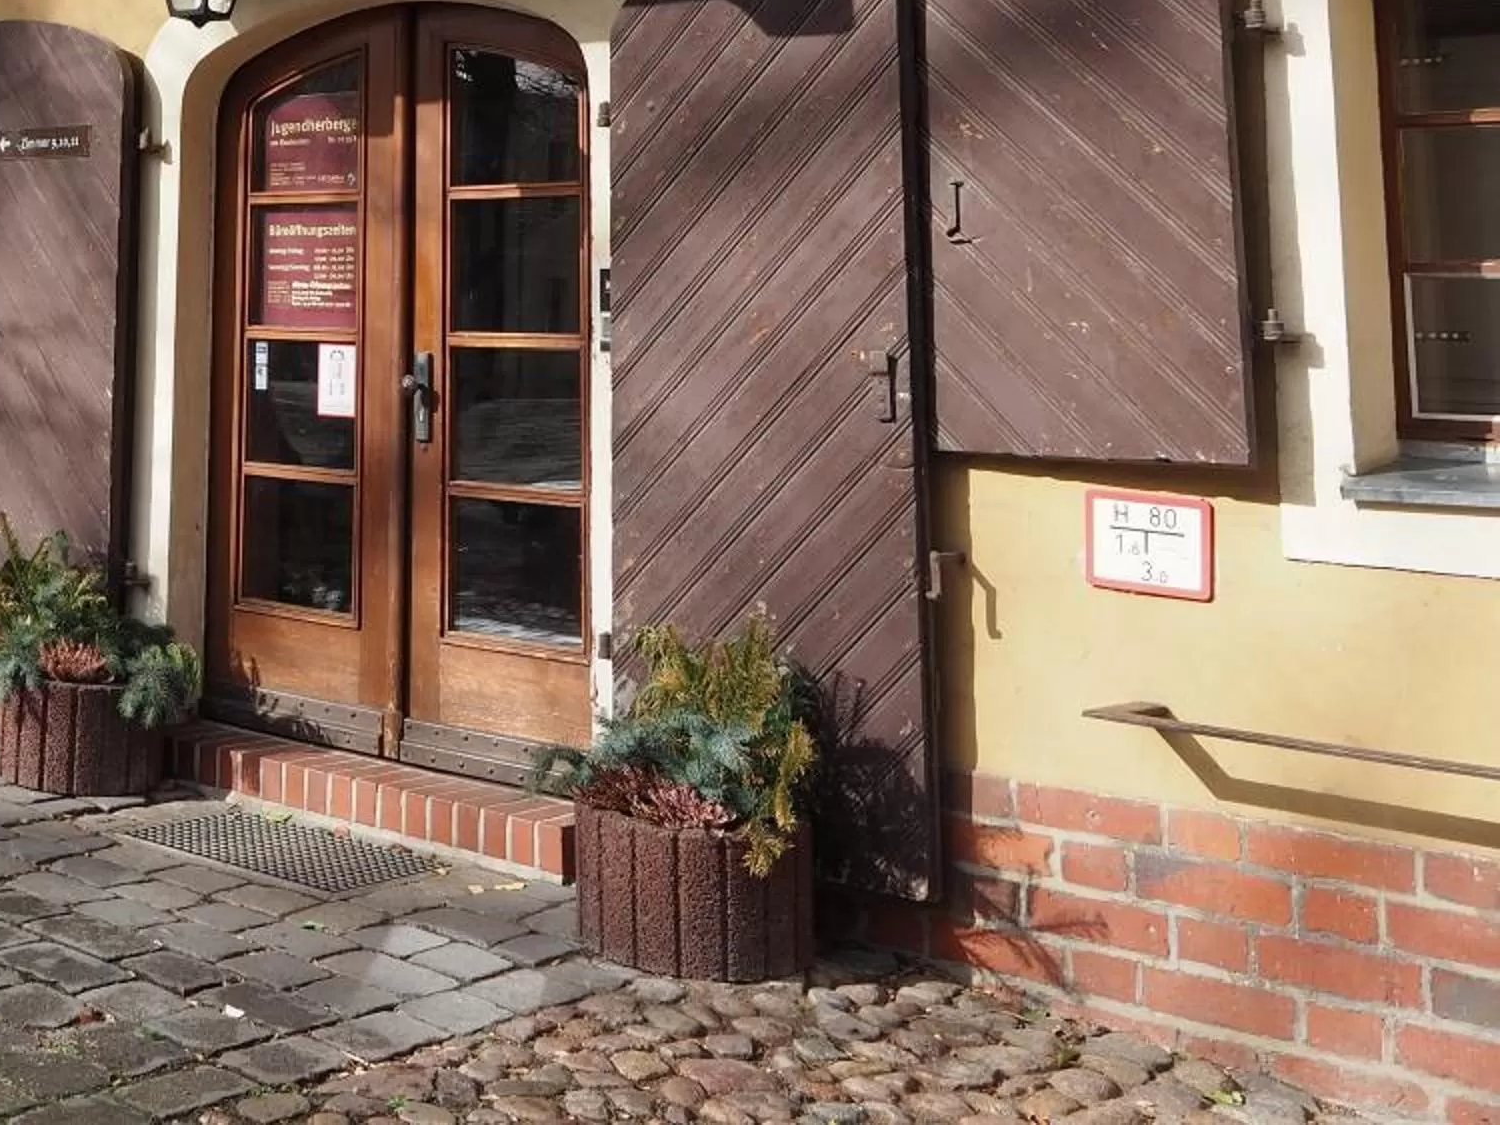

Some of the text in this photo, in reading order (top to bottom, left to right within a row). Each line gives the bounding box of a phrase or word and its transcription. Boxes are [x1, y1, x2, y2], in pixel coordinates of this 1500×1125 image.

[271, 117, 357, 137] Jugendherberge
[1113, 503, 1177, 529] H 80
